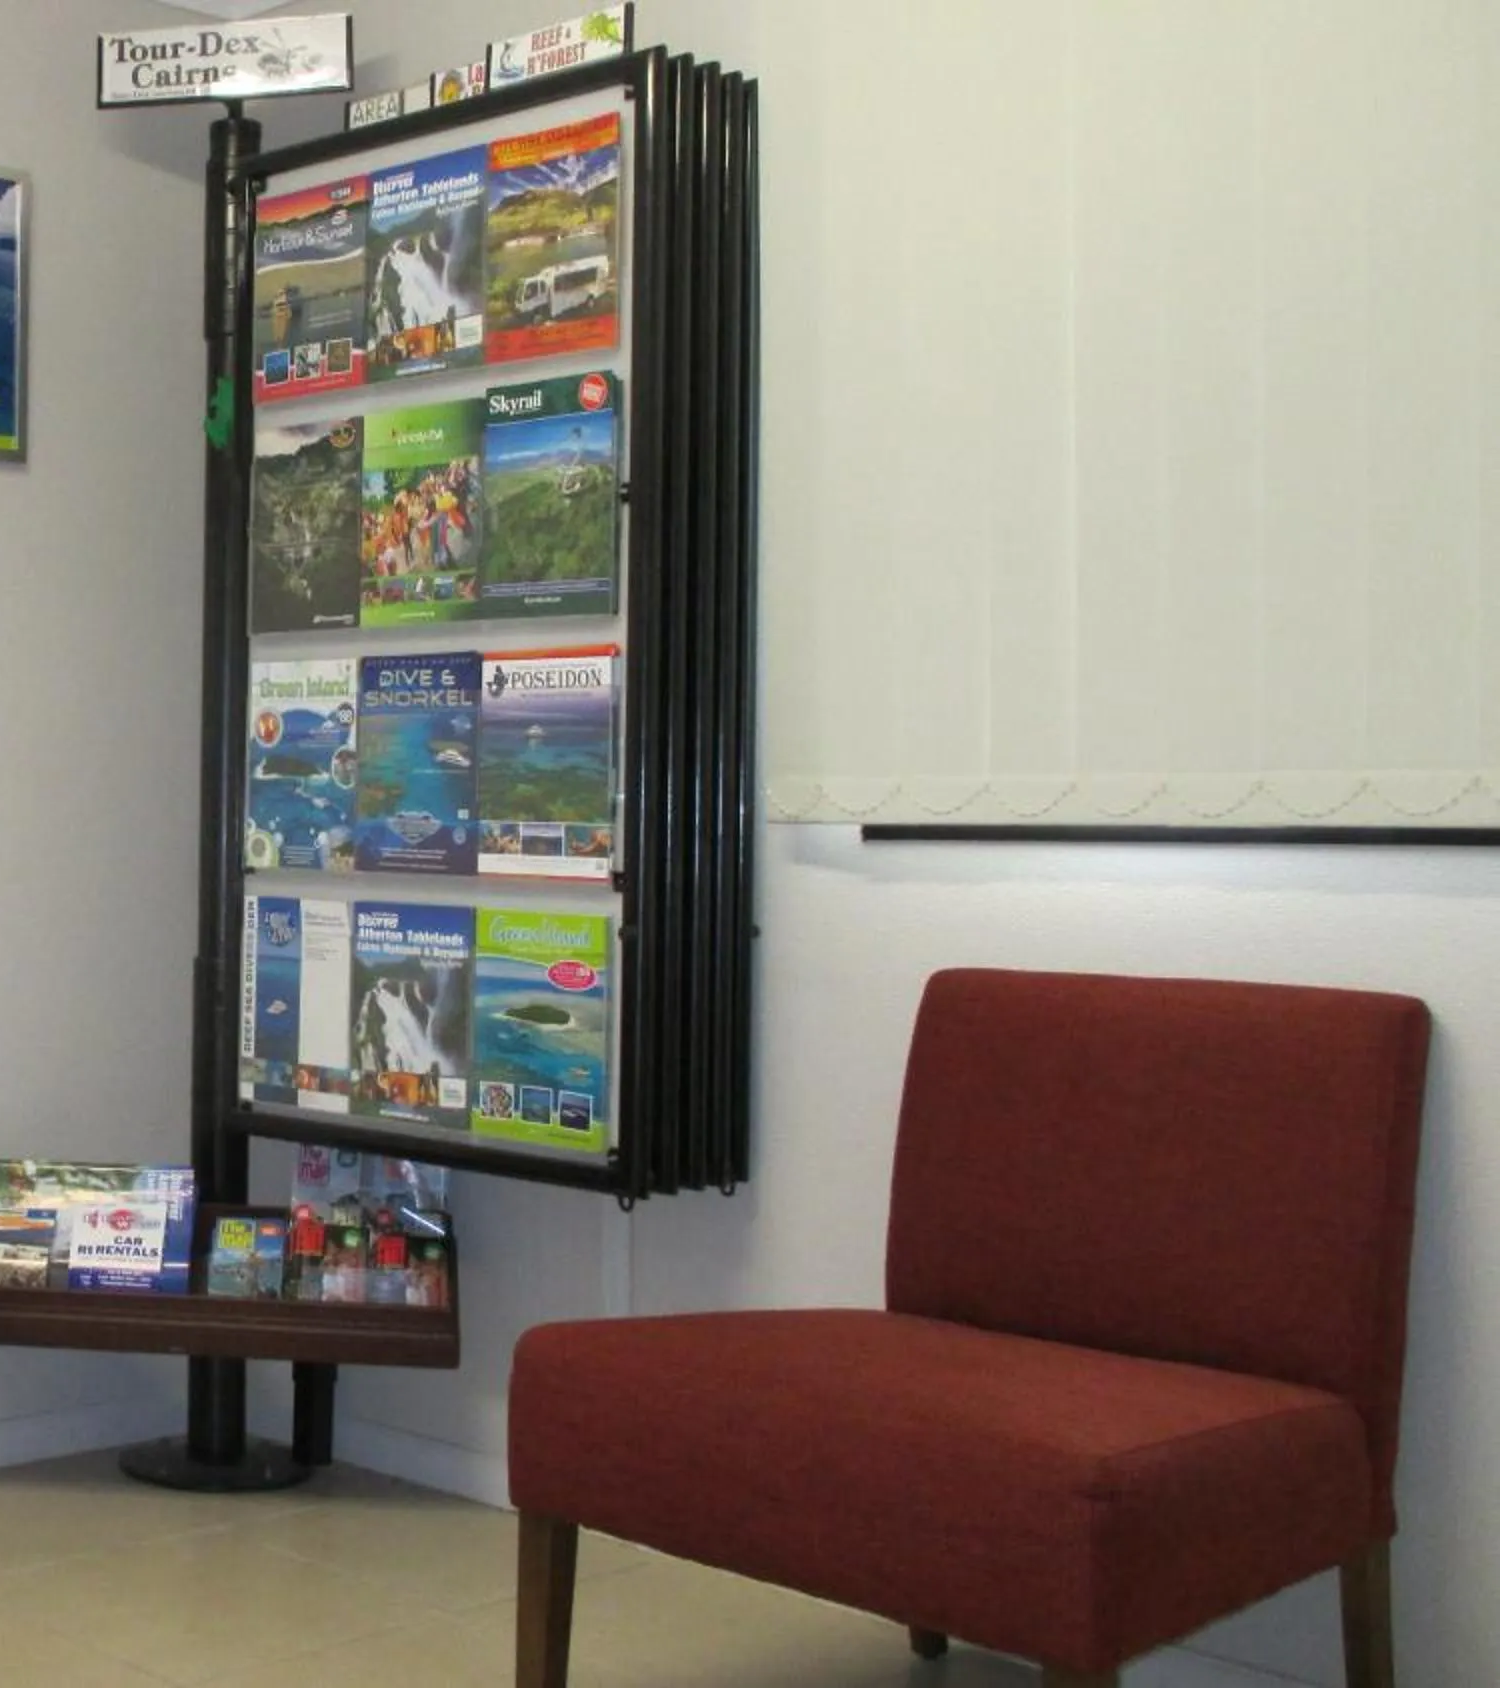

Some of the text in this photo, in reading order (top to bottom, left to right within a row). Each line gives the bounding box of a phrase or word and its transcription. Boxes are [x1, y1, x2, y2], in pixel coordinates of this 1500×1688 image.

[108, 31, 261, 63] Tour-Dex
[530, 24, 564, 52] REEF
[352, 94, 397, 124] AREA
[489, 388, 543, 416] Skyrail
[378, 668, 433, 687] DIVE
[511, 667, 603, 689] POSEIDON
[363, 687, 473, 708] SNORKEL
